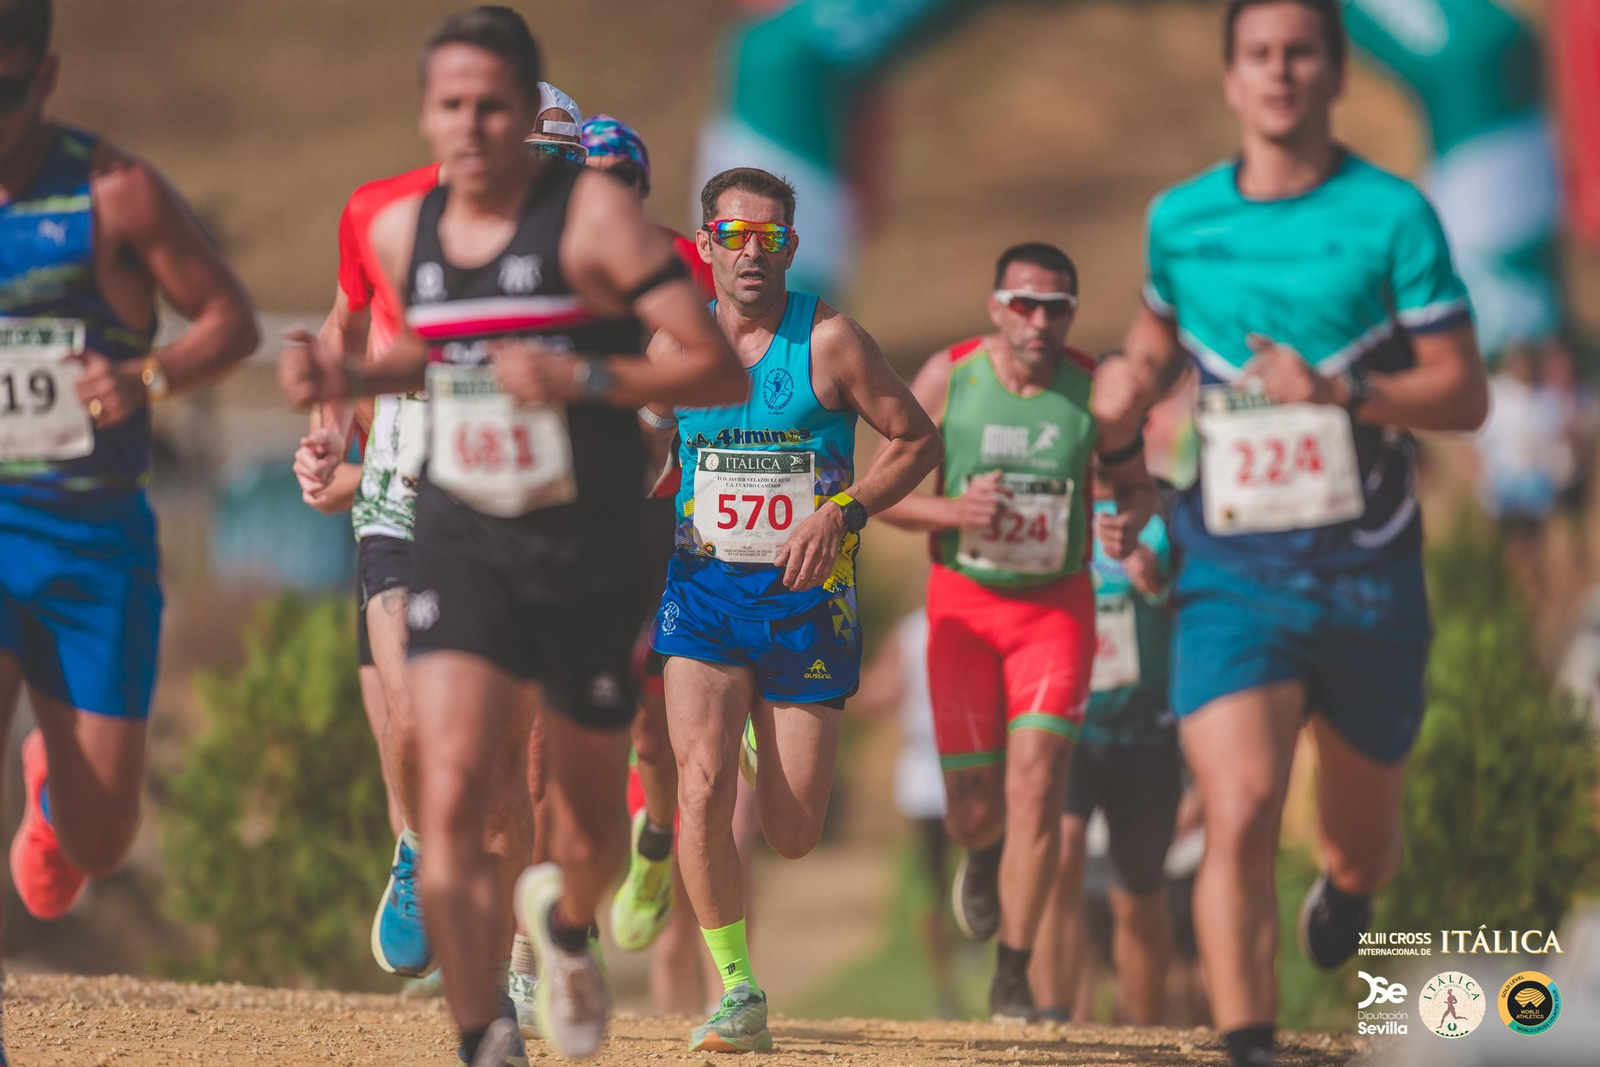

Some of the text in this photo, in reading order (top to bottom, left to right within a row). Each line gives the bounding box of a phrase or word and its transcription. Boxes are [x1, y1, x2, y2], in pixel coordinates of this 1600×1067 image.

[726, 455, 781, 470] ITÁLICA
[1233, 434, 1325, 488] 224
[717, 494, 793, 531] 570
